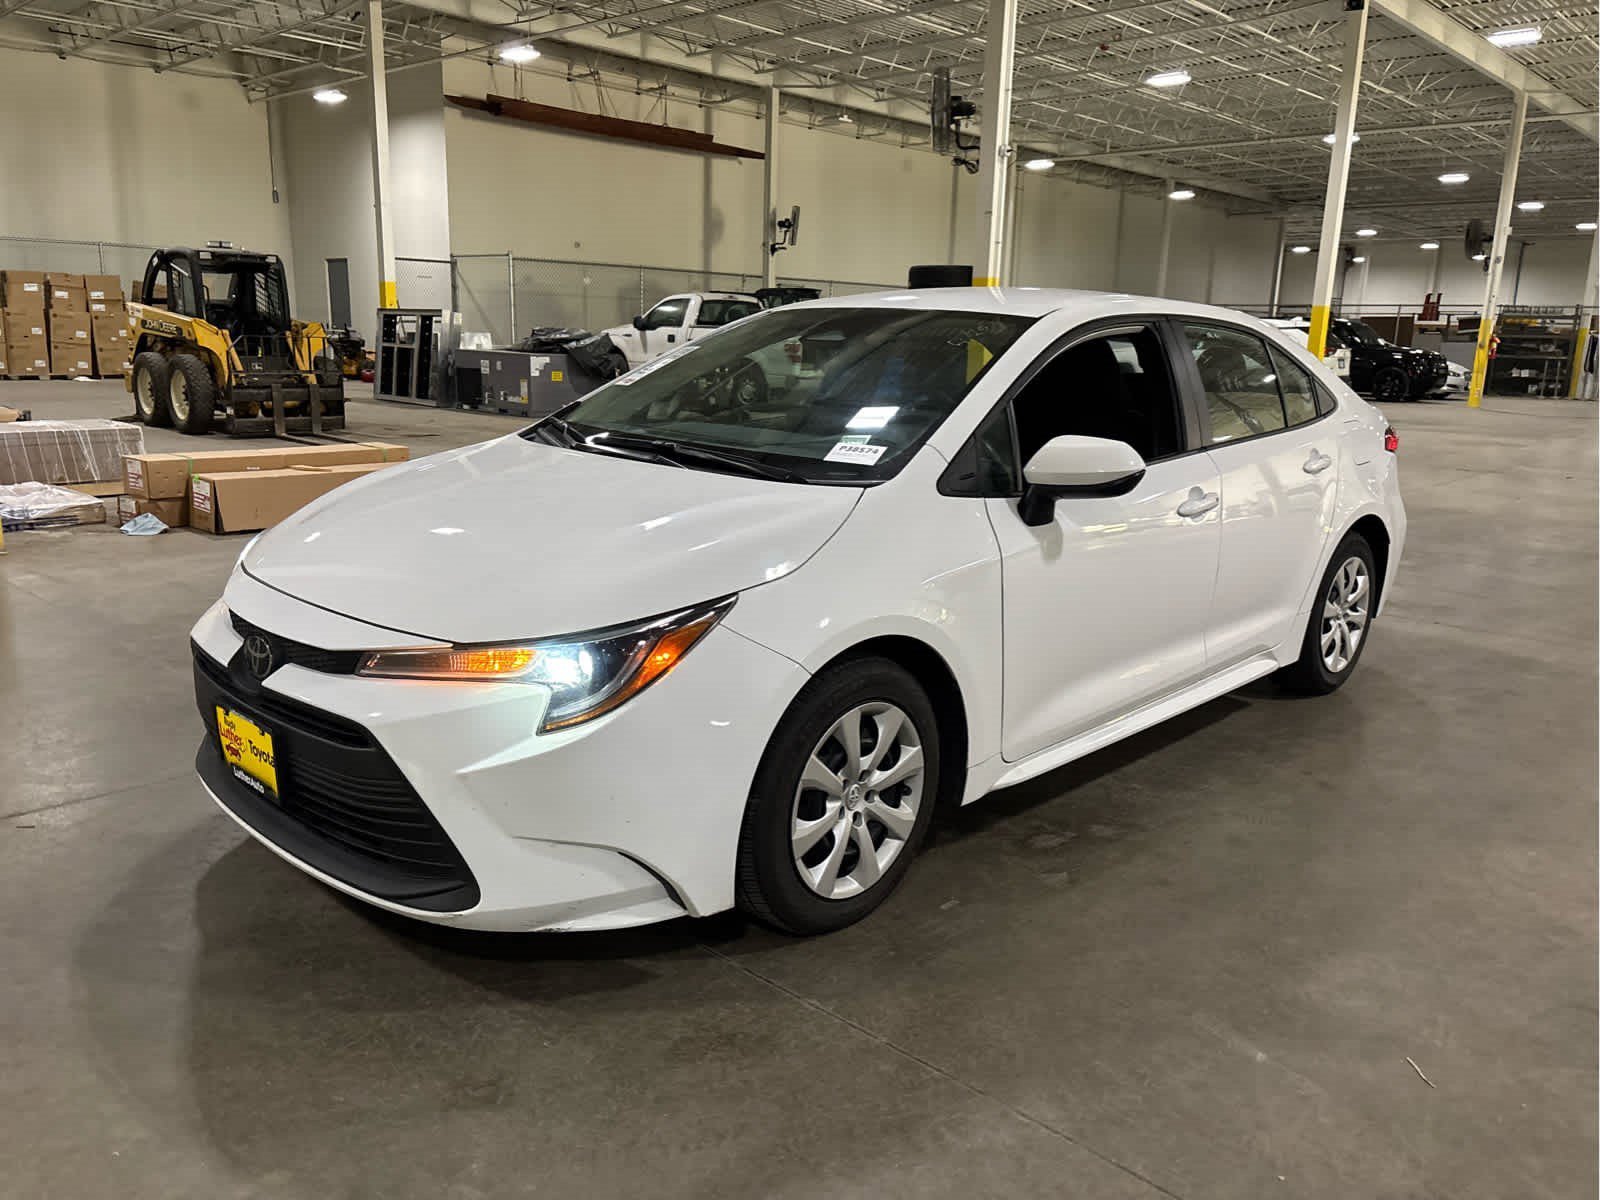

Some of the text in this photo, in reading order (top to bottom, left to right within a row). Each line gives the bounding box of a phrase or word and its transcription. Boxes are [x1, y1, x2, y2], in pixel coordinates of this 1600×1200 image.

[159, 319, 177, 334] DEERE
[839, 445, 880, 455] P38574
[218, 722, 242, 746] Luther
[248, 739, 276, 768] Toyota
